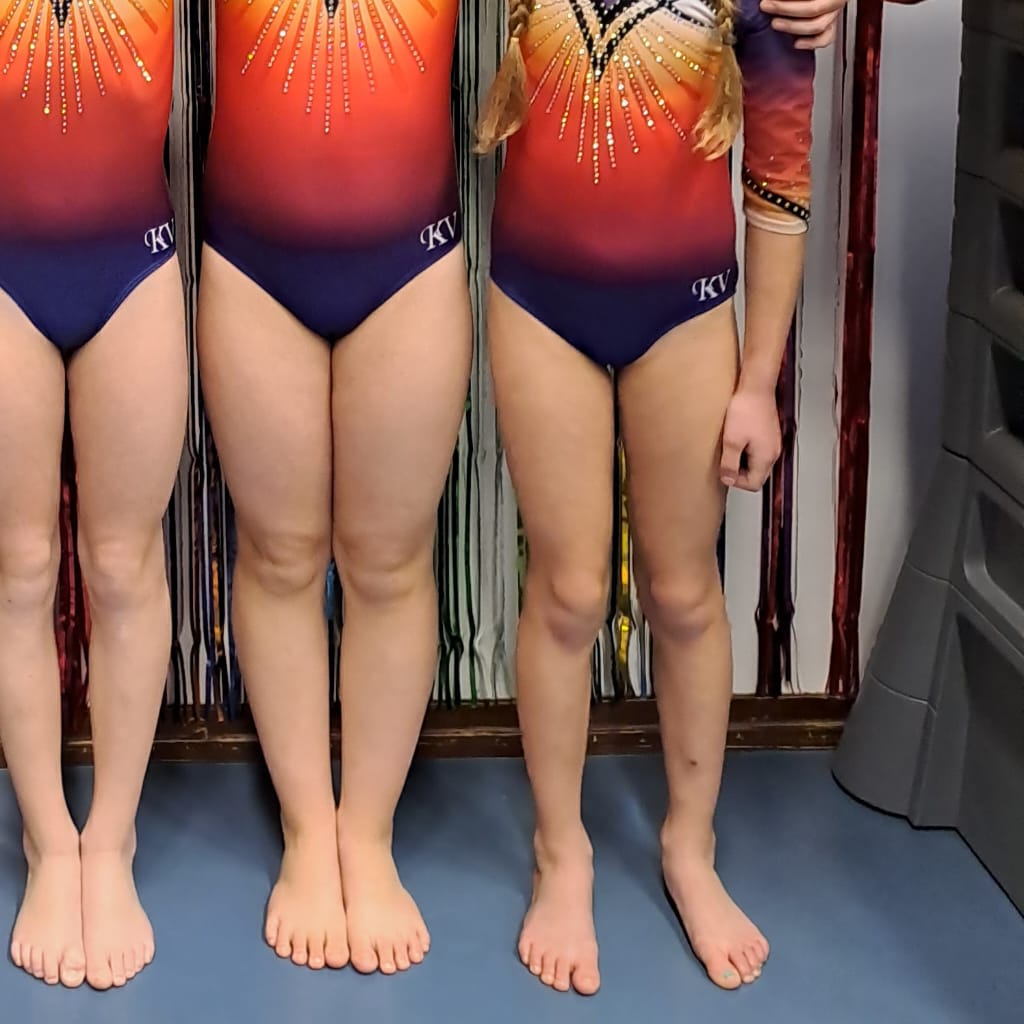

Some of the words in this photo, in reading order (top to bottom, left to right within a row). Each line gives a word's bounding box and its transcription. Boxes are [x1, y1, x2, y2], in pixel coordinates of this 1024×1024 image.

[144, 218, 175, 254] KV
[420, 211, 458, 252] KV
[691, 268, 732, 302] KV
